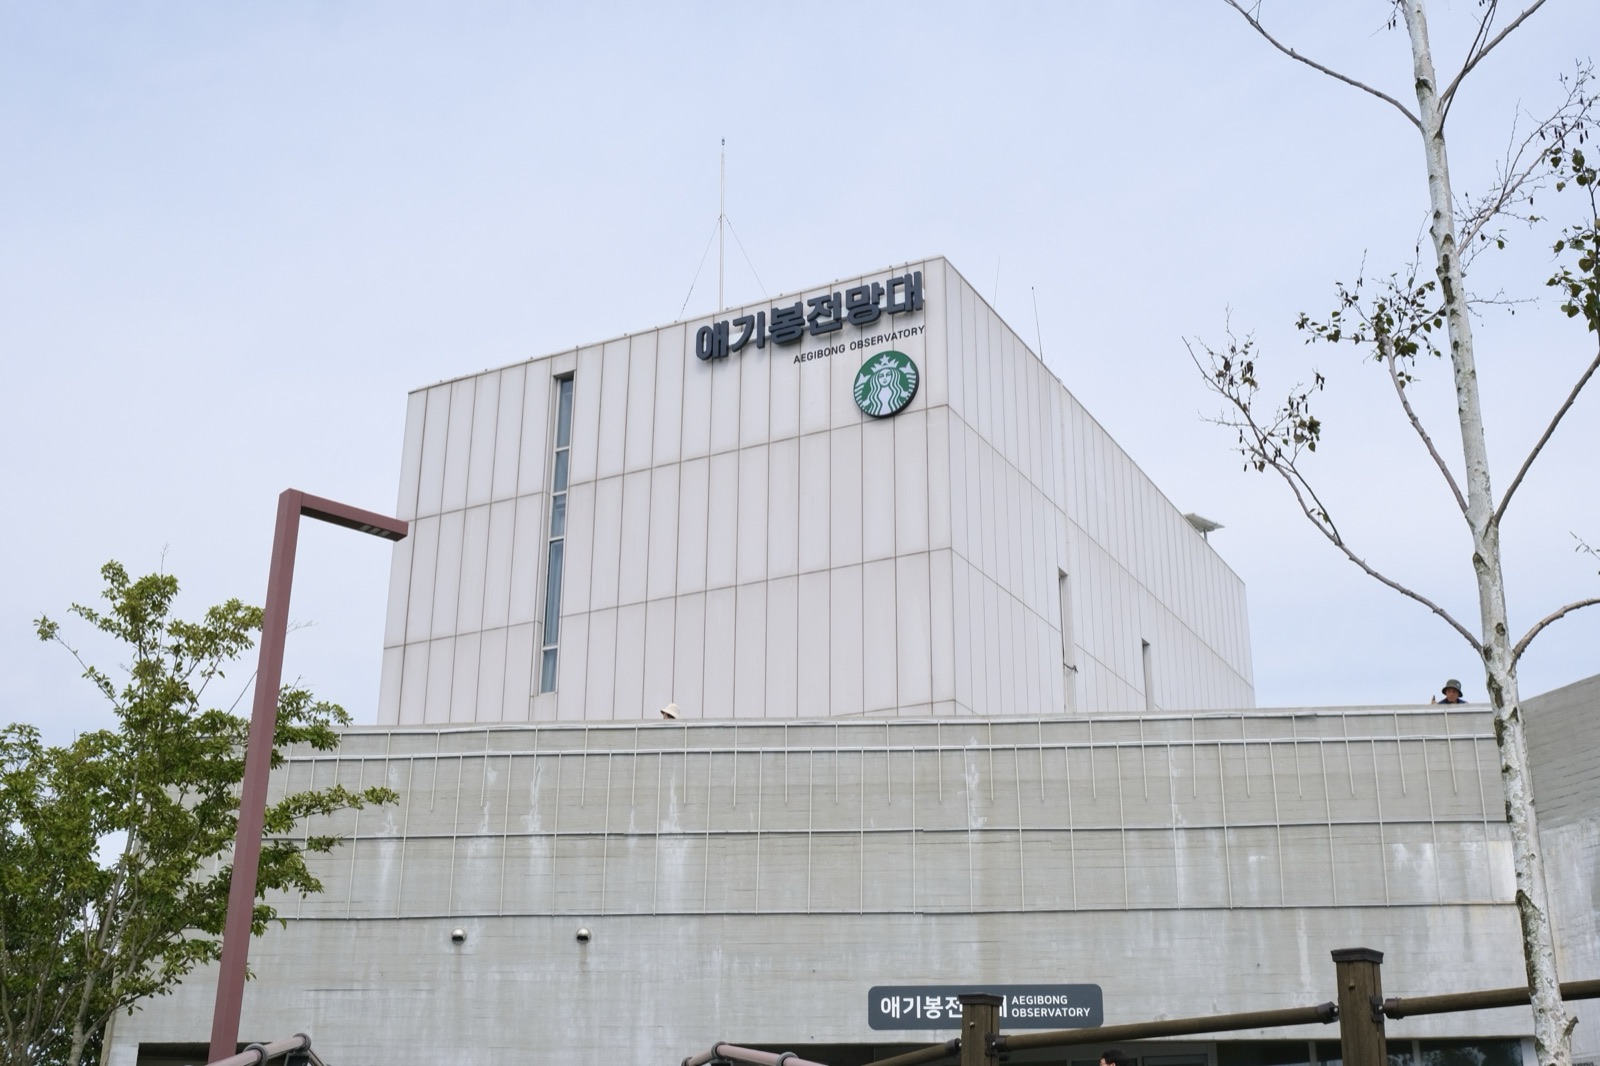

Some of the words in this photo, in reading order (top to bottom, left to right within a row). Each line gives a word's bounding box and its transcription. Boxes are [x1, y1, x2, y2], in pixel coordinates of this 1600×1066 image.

[695, 271, 923, 361] 애기봉전망대
[793, 344, 846, 364] AEGIBONG
[849, 325, 926, 351] OBSERVATORY
[880, 995, 1007, 1019] 애기봉전
[1011, 995, 1068, 1006] AEGIBONG
[1011, 1007, 1091, 1018] OBSERVATORY
